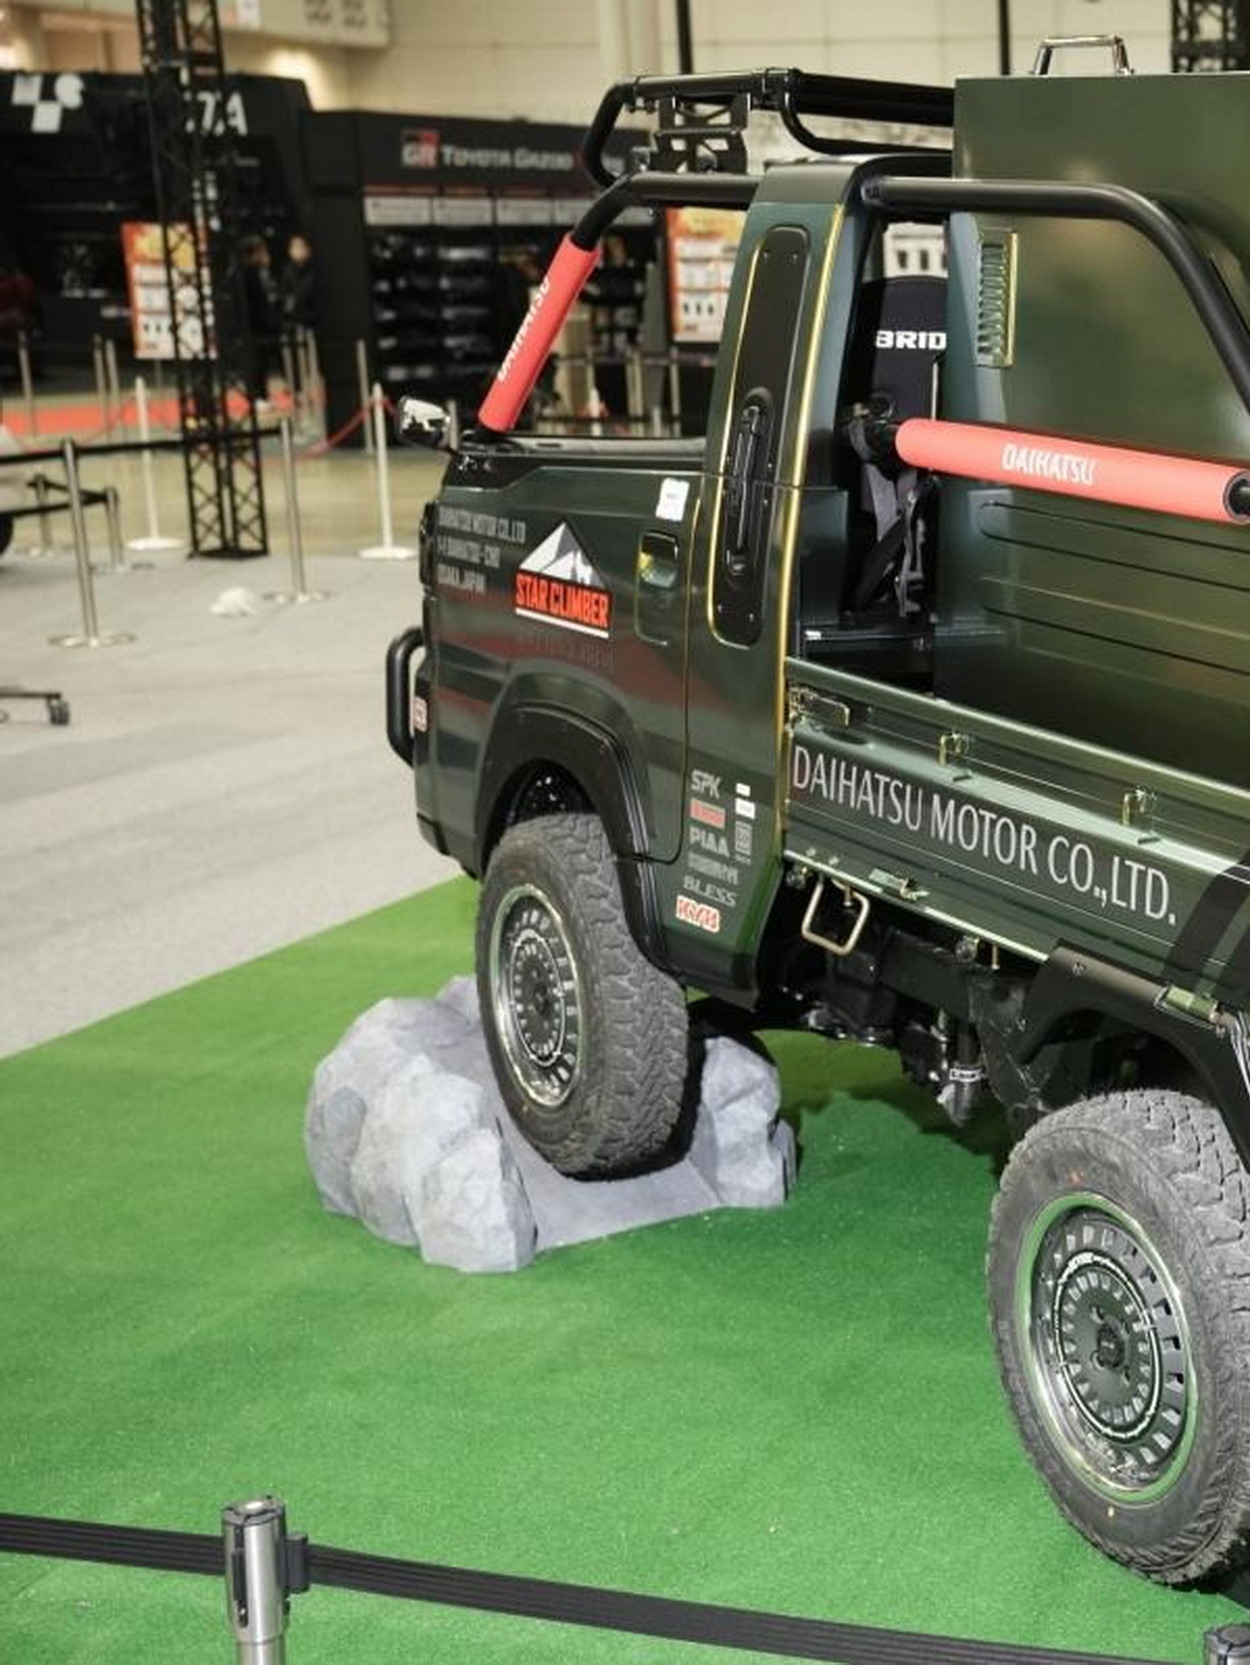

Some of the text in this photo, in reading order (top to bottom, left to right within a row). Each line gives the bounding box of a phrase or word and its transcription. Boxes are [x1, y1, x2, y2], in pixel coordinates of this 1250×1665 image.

[1001, 442, 1099, 487] DAIHATSU
[516, 573, 610, 629] STAR CLIMBER
[691, 768, 721, 800] SPK
[688, 824, 731, 859] PIAA
[793, 745, 1177, 926] DAIHATSU MOTOR CO.,LTD.
